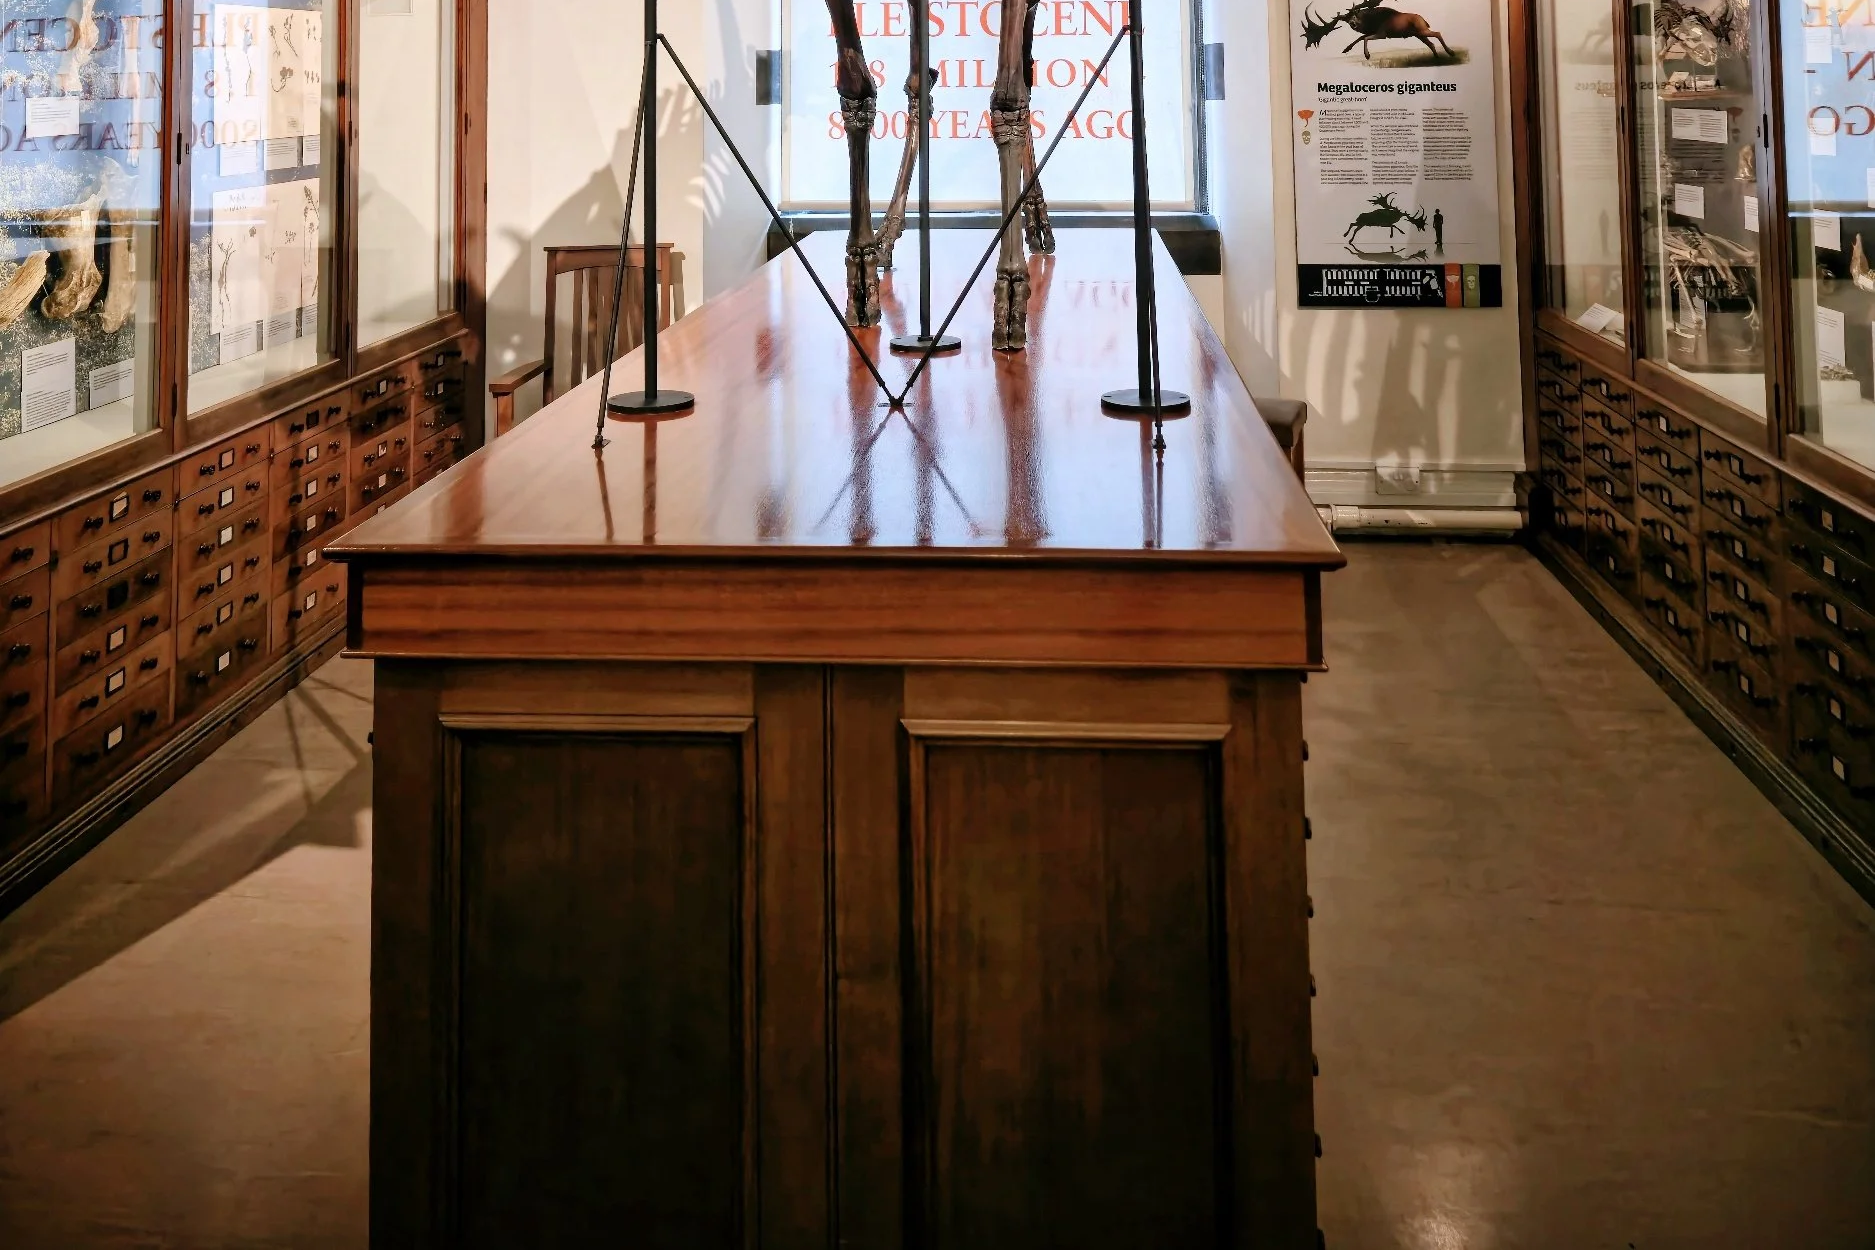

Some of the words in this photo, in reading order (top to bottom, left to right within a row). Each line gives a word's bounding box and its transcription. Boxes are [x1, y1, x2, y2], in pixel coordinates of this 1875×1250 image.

[827, 0, 1145, 37] LESTOEN
[934, 58, 1109, 88] ILION
[1317, 82, 1395, 96] Megaloceros
[1396, 81, 1457, 95] giganteus
[828, 110, 909, 139] 800
[928, 110, 1046, 139] YEAS
